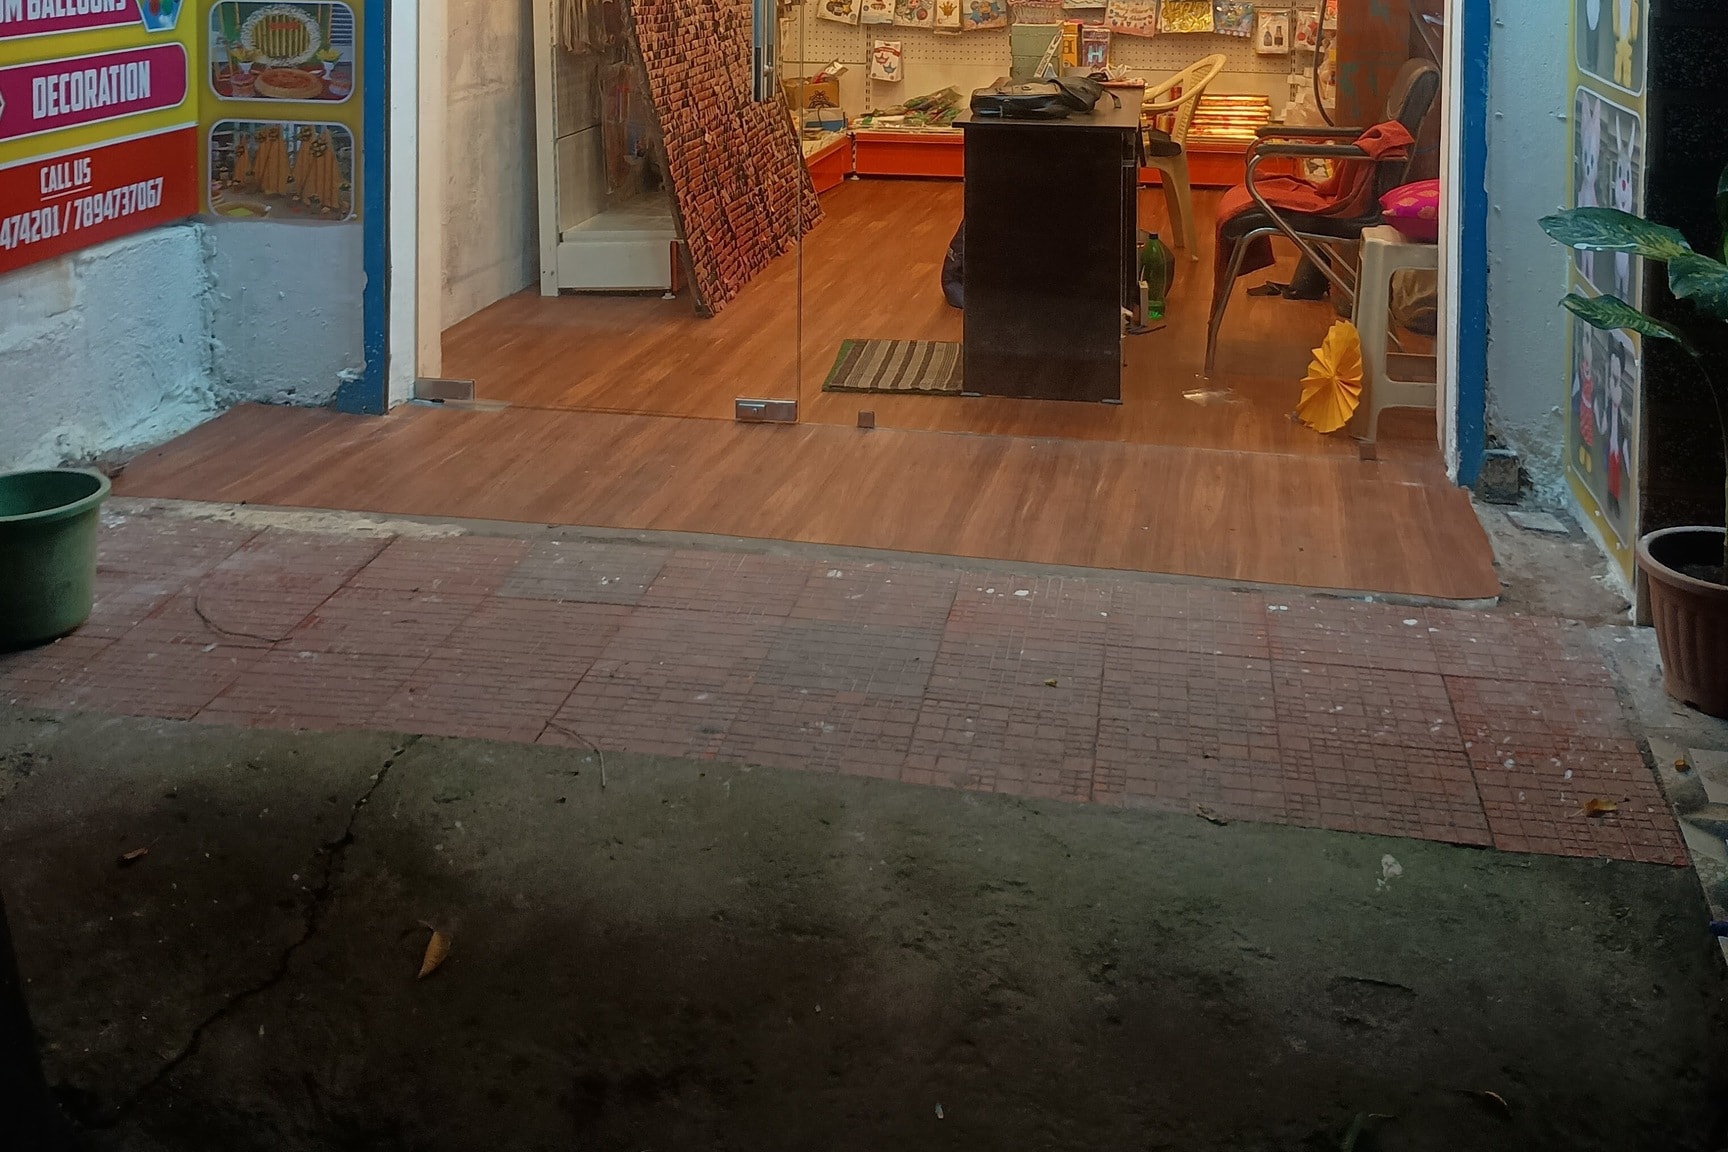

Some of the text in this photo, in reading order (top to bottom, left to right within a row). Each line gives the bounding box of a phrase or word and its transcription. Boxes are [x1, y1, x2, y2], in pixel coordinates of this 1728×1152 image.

[32, 60, 151, 120] DECORATION
[40, 157, 92, 194] CALL US
[74, 176, 164, 231] 7894737067
